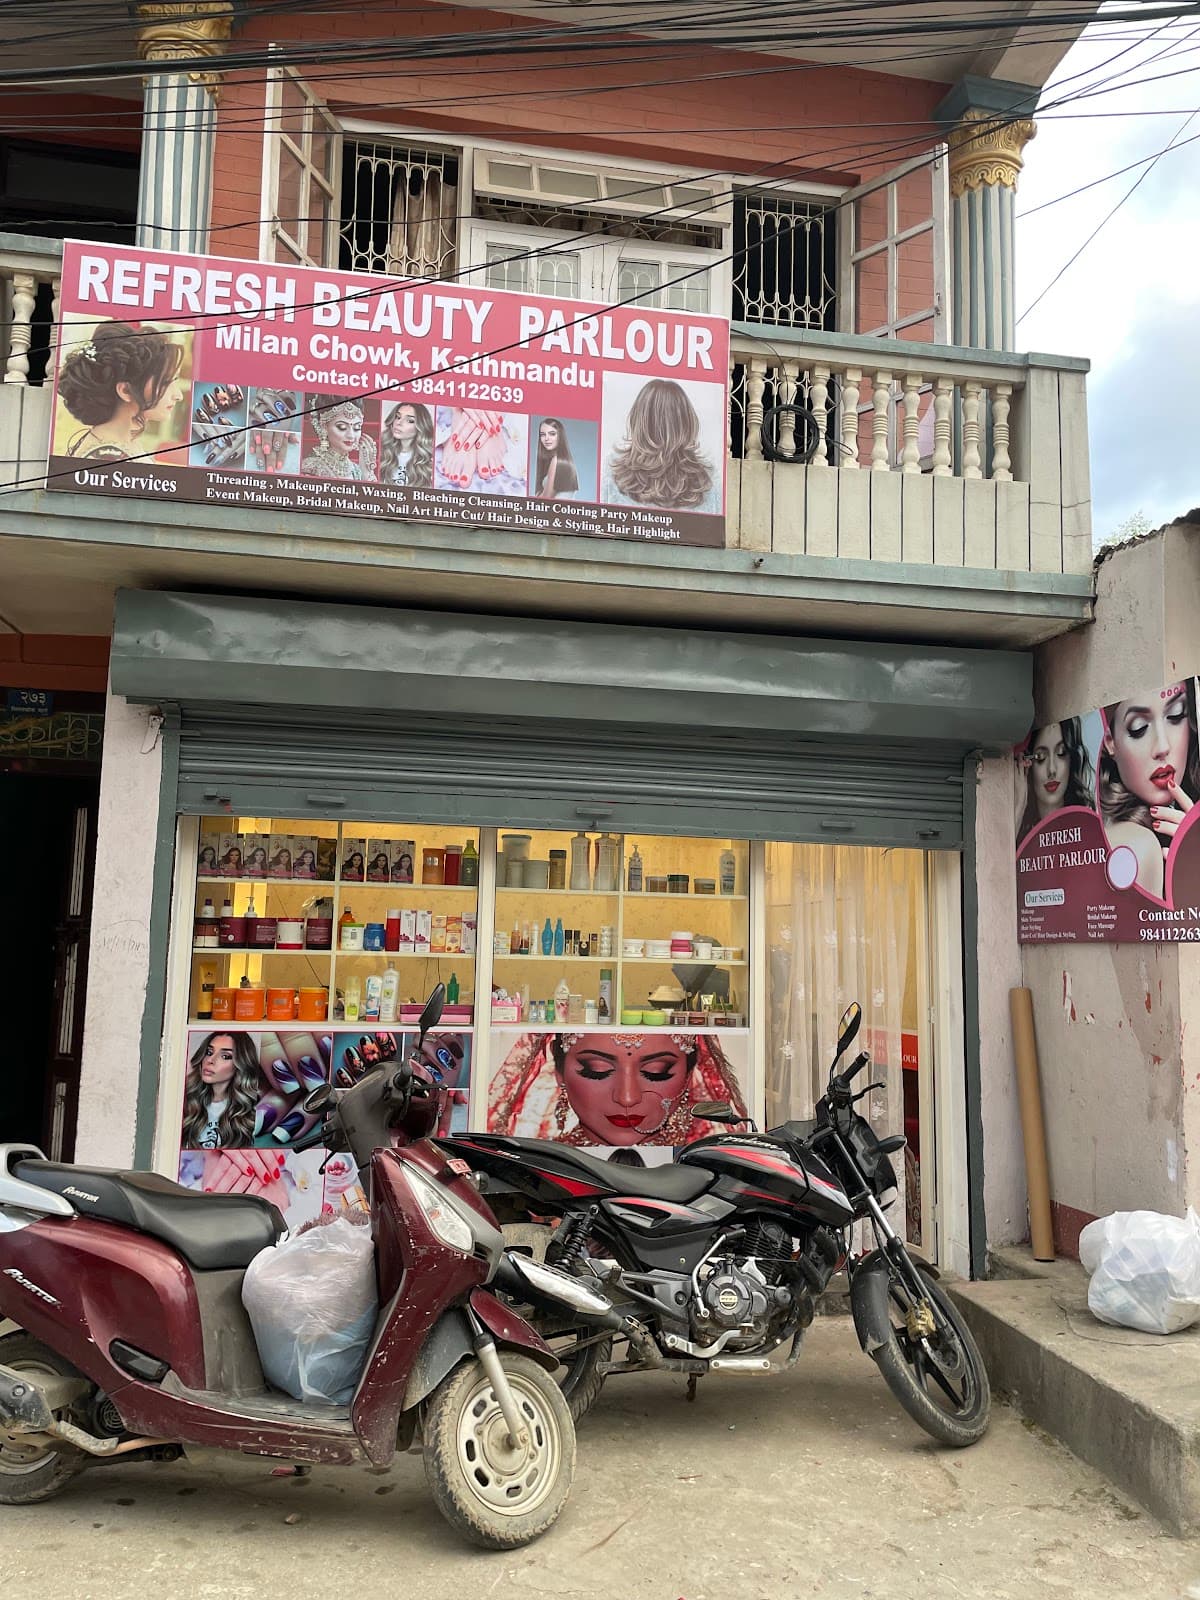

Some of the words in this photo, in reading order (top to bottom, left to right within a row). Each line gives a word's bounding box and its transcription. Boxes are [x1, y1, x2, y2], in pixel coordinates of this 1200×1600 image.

[77, 255, 296, 323] REFRESH
[312, 281, 494, 343] BEAUTY
[519, 305, 714, 370] PARLOUR
[215, 323, 299, 356] Milan
[310, 333, 420, 374] Chowk,
[431, 346, 595, 388] Kathmandu
[292, 365, 368, 388] Contact
[375, 373, 405, 391] No.
[411, 379, 524, 403] 9841122639
[74, 469, 108, 487] Our
[112, 470, 177, 492] Services
[206, 487, 240, 500] Event
[243, 490, 293, 506] Makeup,
[297, 495, 332, 508] Bridal
[335, 498, 383, 514] Makeup,
[386, 503, 409, 515] Nail
[412, 506, 430, 516] Art
[434, 508, 459, 518] Hair
[461, 510, 485, 521] Cut/
[487, 512, 512, 524] Hair
[515, 515, 549, 528] Design
[552, 518, 562, 528] &
[565, 519, 604, 533] Styling,
[607, 523, 631, 535] Hair
[633, 526, 681, 539] Highlight
[276, 478, 359, 496] MakeupFecial,
[362, 486, 407, 500] Waxing,
[413, 490, 465, 506] Bleaching
[468, 496, 523, 512] Cleansing,
[526, 501, 550, 512] Hair
[552, 503, 597, 519] Coloring
[600, 508, 628, 521] Party
[631, 511, 673, 526] Makeup
[1039, 827, 1082, 848] REFRESH
[1020, 854, 1055, 873] BEAUTY
[1059, 848, 1107, 868] PARLOUR
[1025, 894, 1038, 904] Our
[1039, 892, 1064, 903] Services
[1139, 909, 1185, 921] Contact
